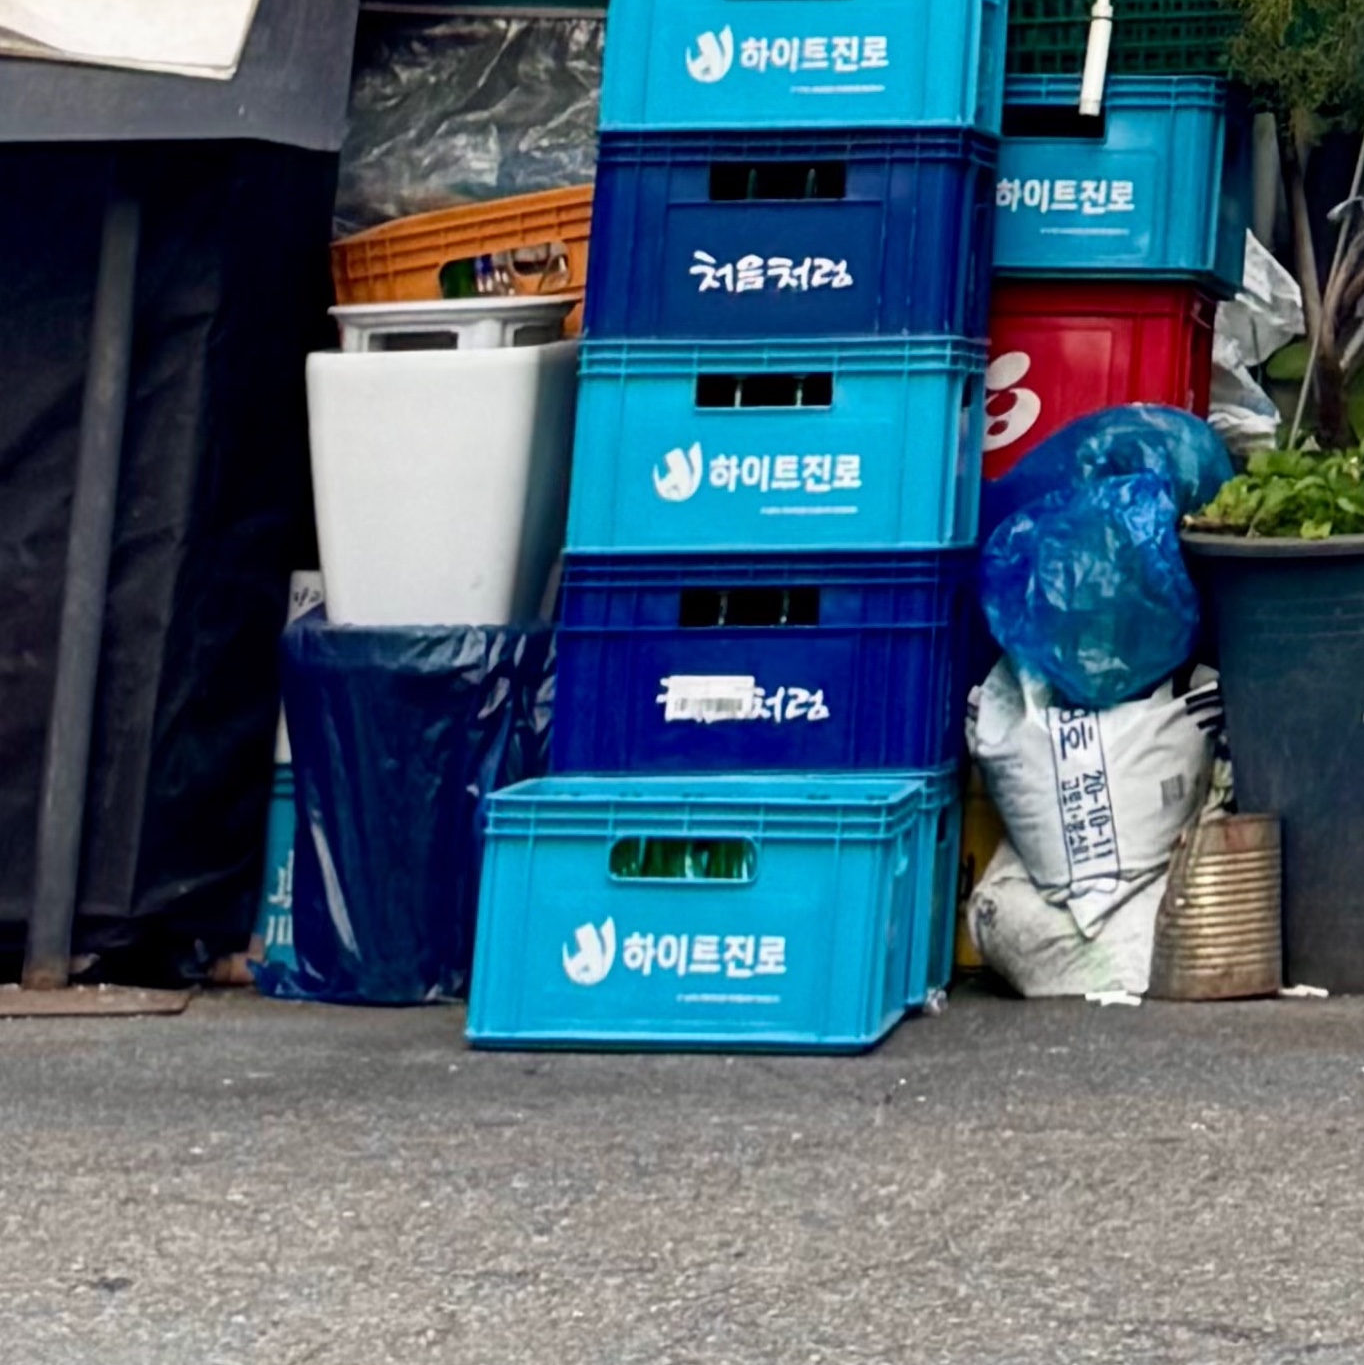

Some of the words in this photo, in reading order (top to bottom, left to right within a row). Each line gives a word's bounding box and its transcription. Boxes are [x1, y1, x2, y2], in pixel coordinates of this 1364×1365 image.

[740, 35, 890, 73] 하이트진로
[996, 178, 1136, 215] 하이트진로
[690, 250, 855, 293] 처음처럼
[708, 452, 862, 493] 하이트진로
[622, 933, 787, 977] 하이트진로
